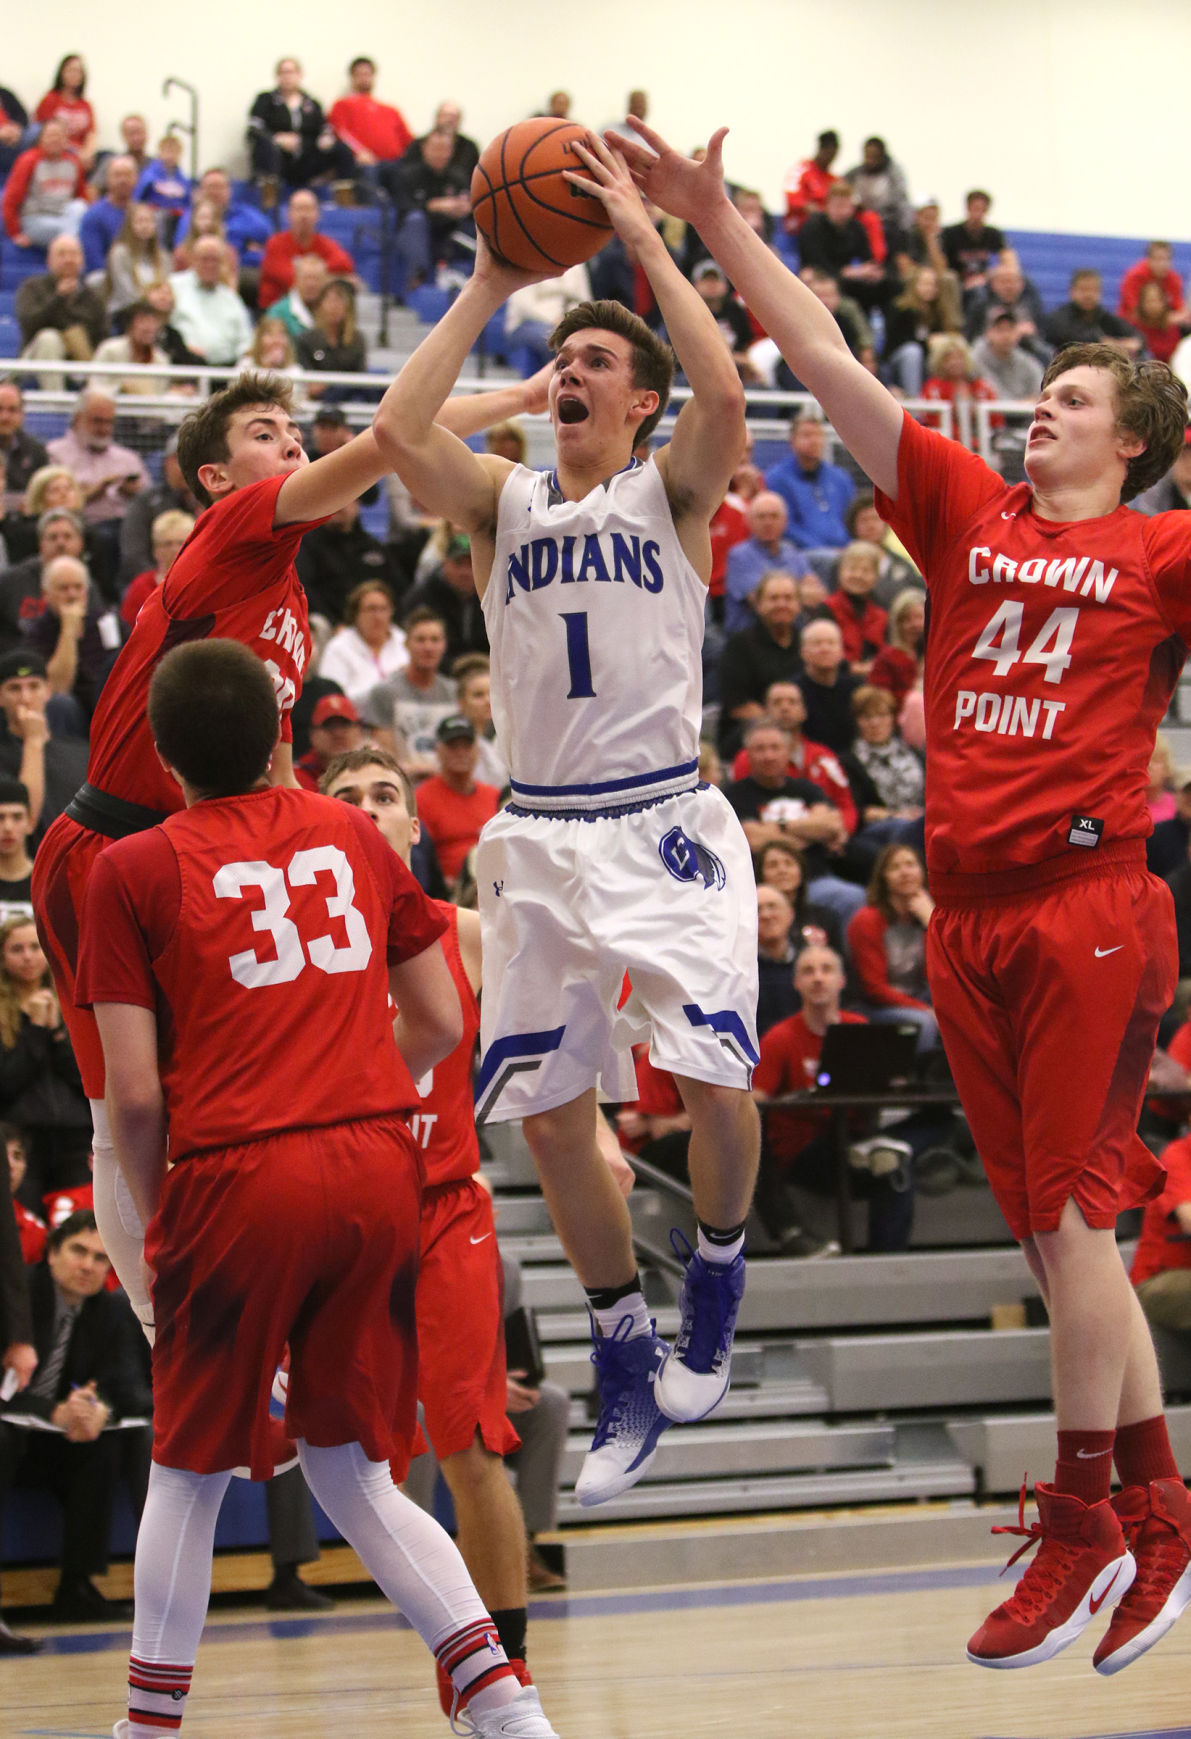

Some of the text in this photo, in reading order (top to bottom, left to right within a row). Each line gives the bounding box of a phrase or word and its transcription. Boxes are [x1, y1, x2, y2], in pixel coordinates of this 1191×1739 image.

[505, 533, 664, 605] NDIANS
[968, 547, 1119, 604] CROWN
[557, 612, 597, 699] 1
[971, 600, 1080, 684] 44
[953, 690, 1066, 739] POINT
[1079, 819, 1095, 831] XL
[212, 845, 373, 989] 33
